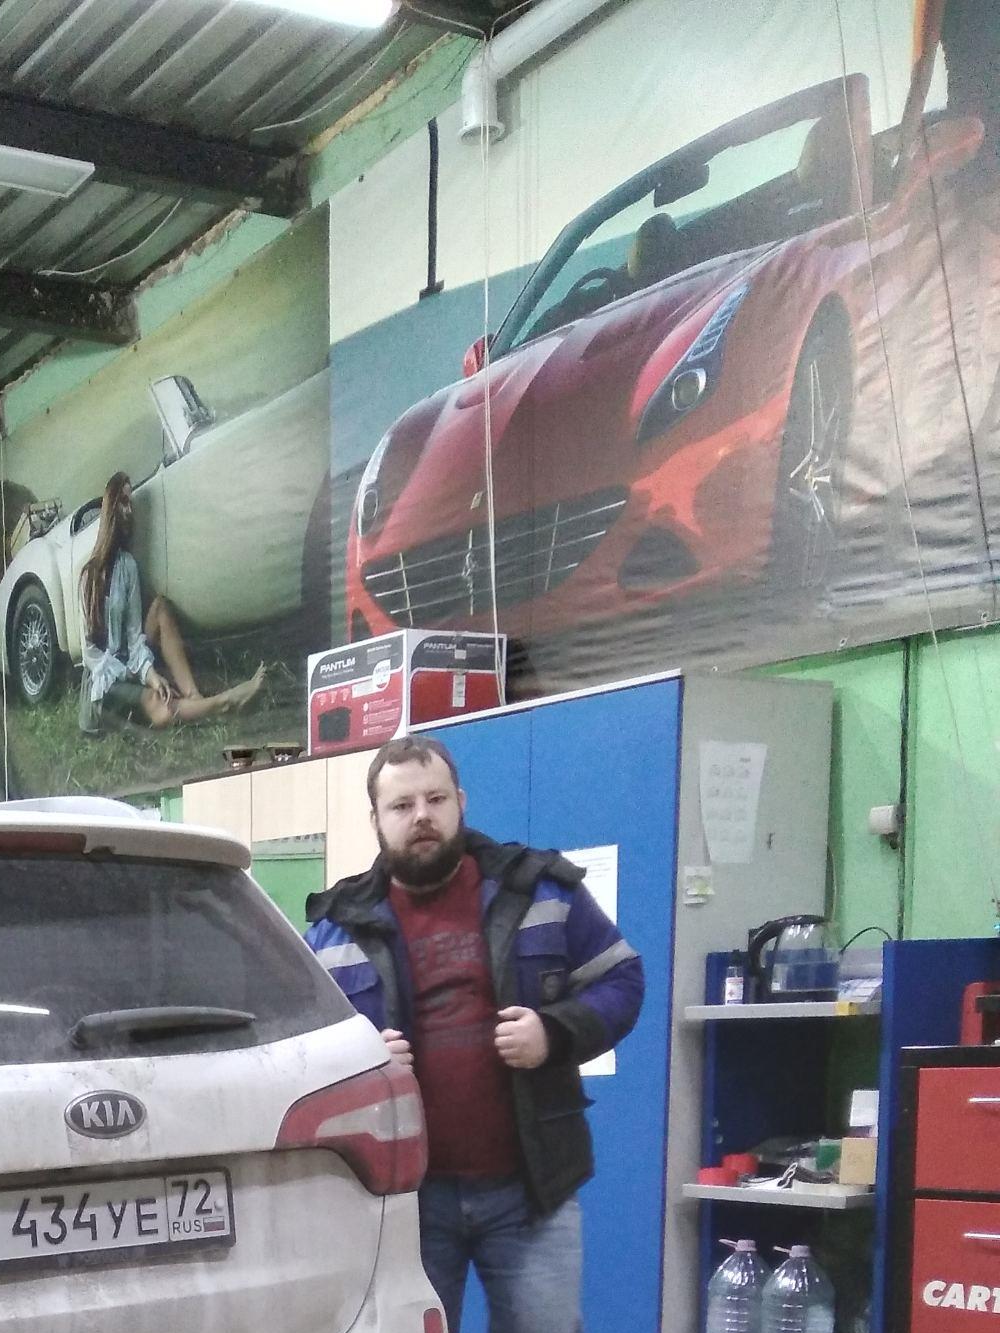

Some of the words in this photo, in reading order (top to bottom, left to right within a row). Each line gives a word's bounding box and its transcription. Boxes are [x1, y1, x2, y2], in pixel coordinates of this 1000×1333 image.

[320, 657, 356, 674] PANTUM
[80, 1100, 136, 1128] KIA
[171, 1180, 213, 1218] 72
[172, 1218, 203, 1234] RUS
